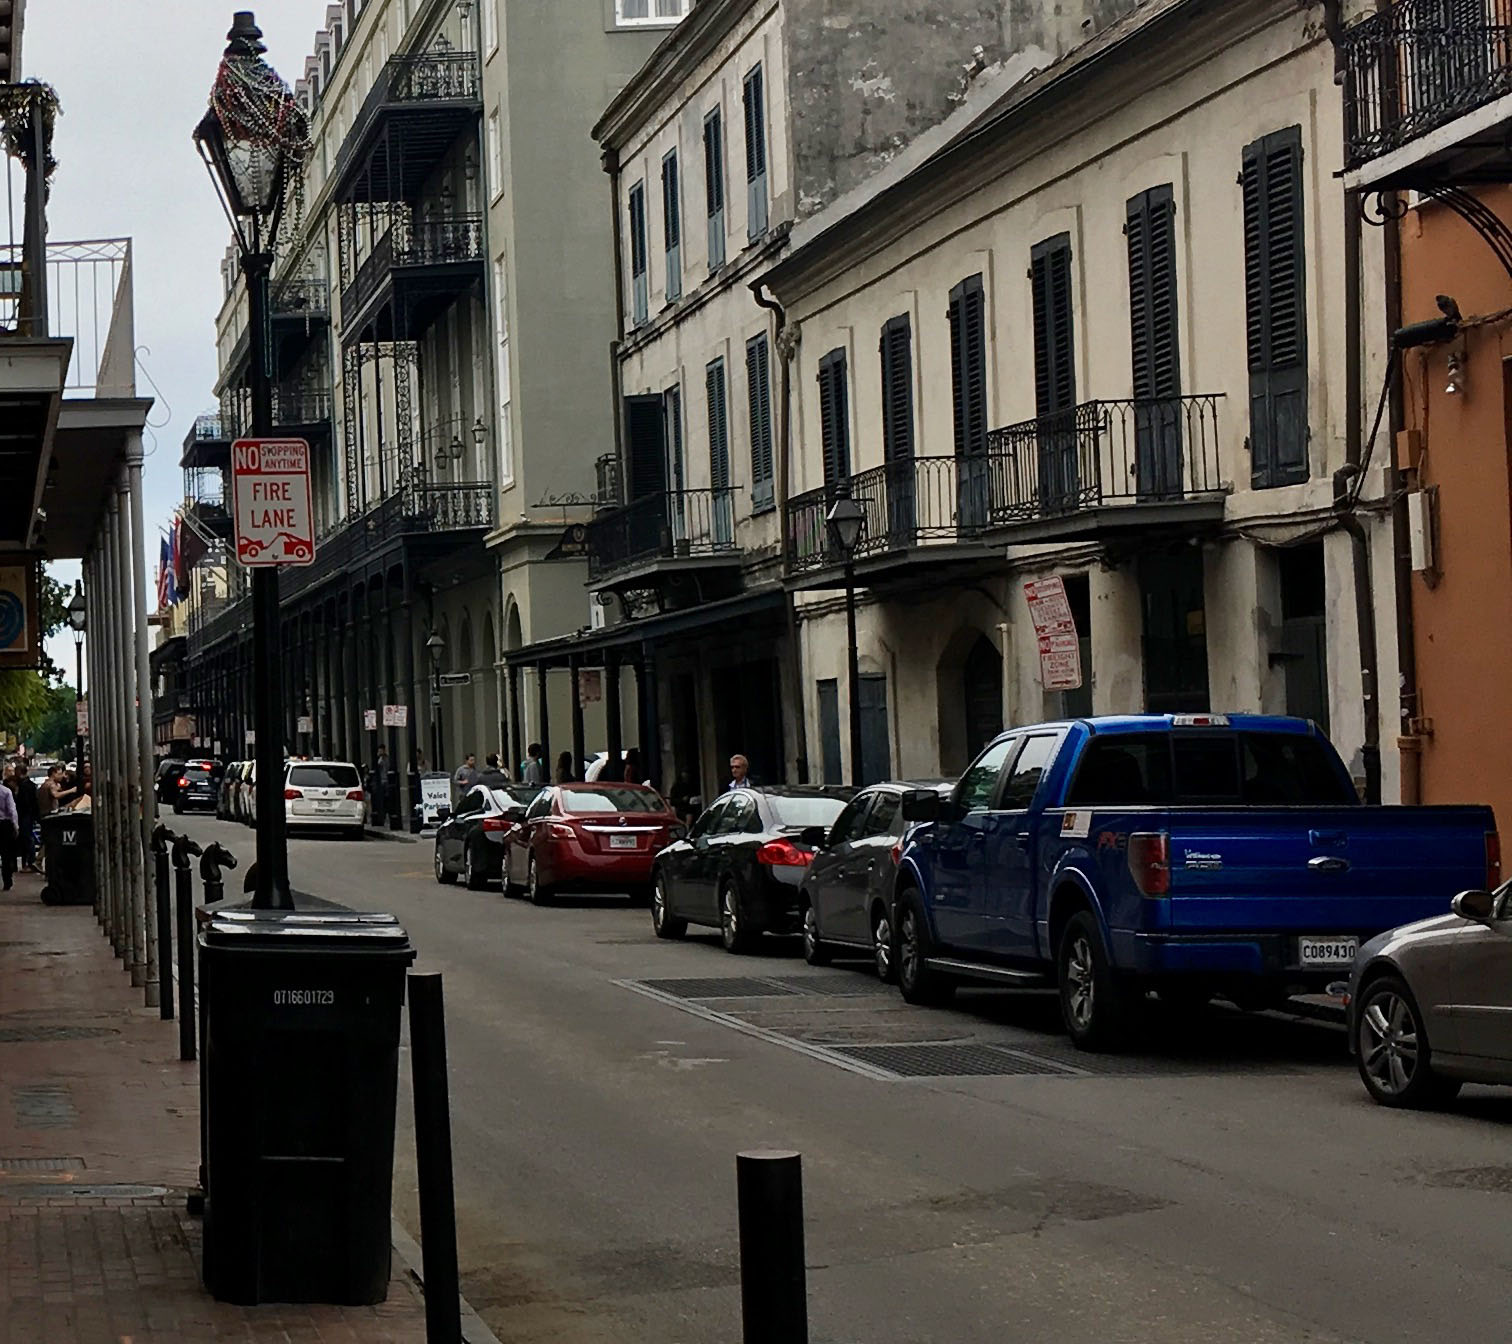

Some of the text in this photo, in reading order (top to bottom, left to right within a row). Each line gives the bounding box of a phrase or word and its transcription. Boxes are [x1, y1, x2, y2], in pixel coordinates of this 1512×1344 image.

[235, 446, 259, 470] NO
[264, 458, 303, 469] ANYTIME
[252, 482, 292, 501] FIRE
[251, 509, 297, 528] LANE
[273, 989, 335, 1005] 0716601729
